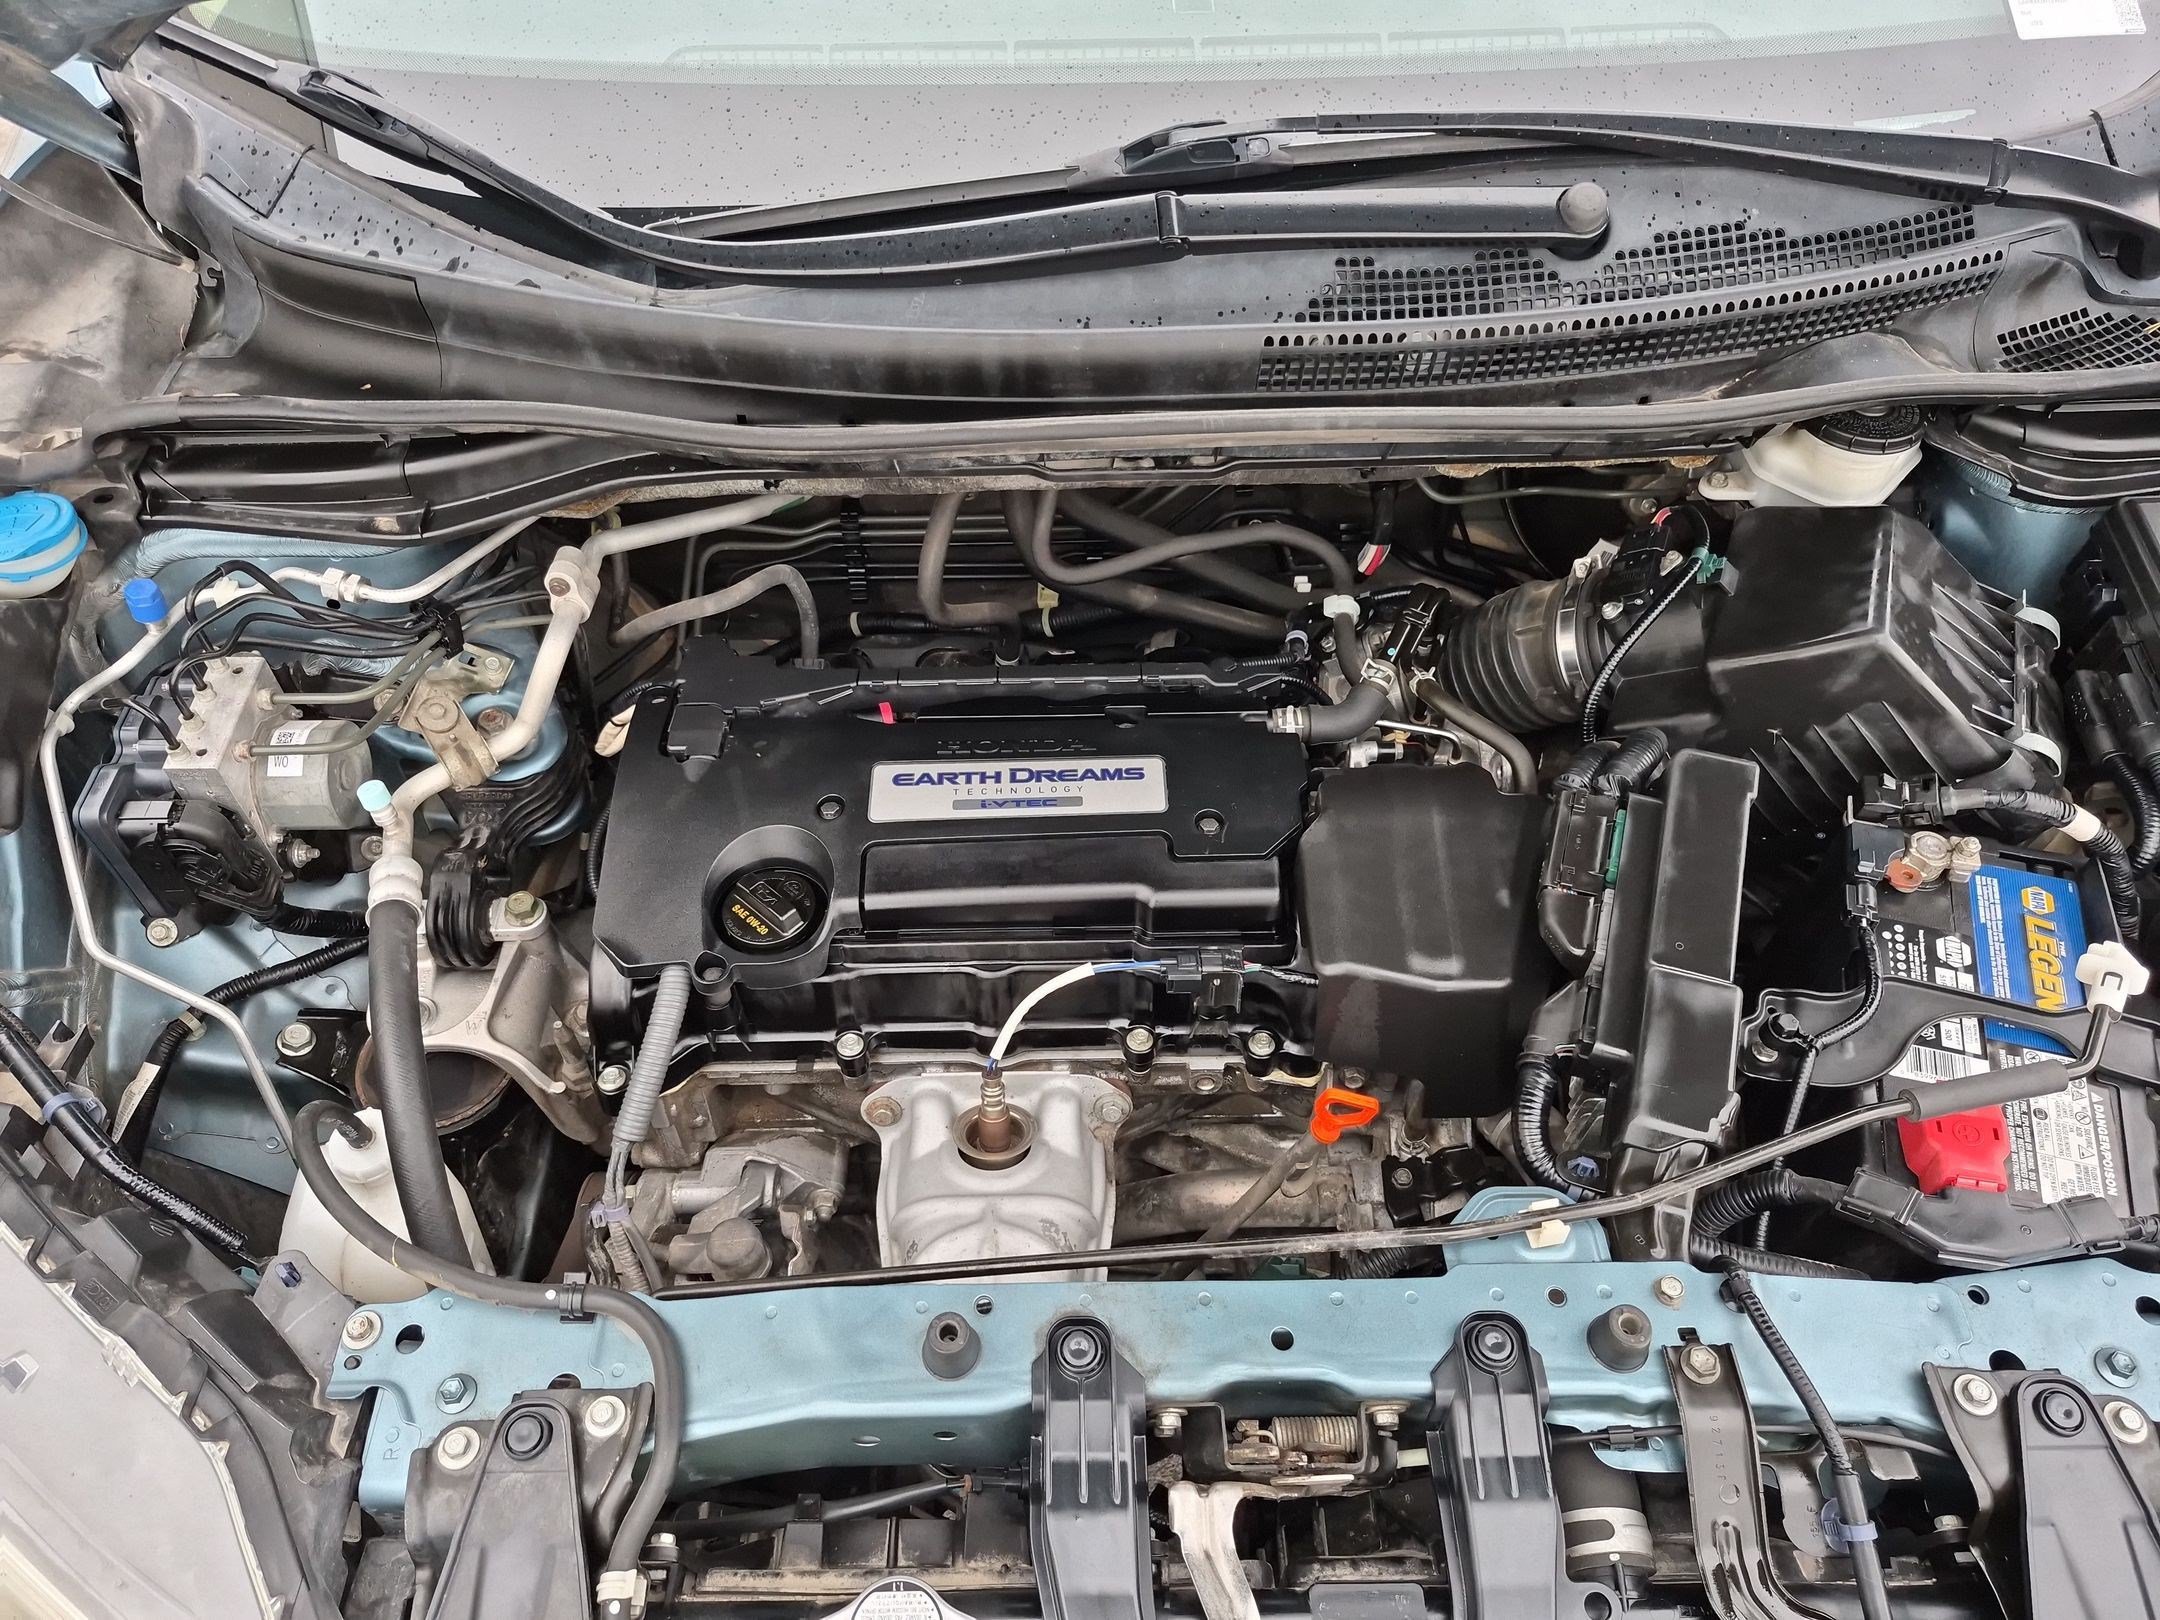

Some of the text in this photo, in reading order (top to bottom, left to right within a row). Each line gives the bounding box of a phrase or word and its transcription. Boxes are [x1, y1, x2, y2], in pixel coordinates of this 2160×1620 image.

[892, 766, 1146, 787] EARTH DREAMS
[953, 785, 1084, 796] TECHNOLOGY
[2029, 891, 2046, 911] NAPA
[731, 904, 749, 919] SAE
[746, 916, 769, 936] 0W-20
[1945, 940, 1963, 963] NAPA
[2058, 941, 2067, 958] THE
[2024, 915, 2068, 1011] LEGEN
[1944, 1029, 1952, 1041] 500
[2005, 1105, 2015, 1127] PROPER
[2015, 1127, 2023, 1138] NOT
[2022, 1114, 2032, 1142] EXPLOSION
[2035, 1121, 2046, 1151] INSTRUCTIONS
[2083, 1128, 2094, 1149] SULFURIC
[2024, 1142, 2033, 1151] OR
[2093, 1103, 2118, 1196] DANGER/POISON
[2017, 1138, 2028, 1178] RECOMMENDED
[2021, 1178, 2030, 1190] FOR
[2028, 1171, 2036, 1180] DO
[2030, 1180, 2038, 1192] NOT
[2090, 1167, 2101, 1195] FLUSH EYES
